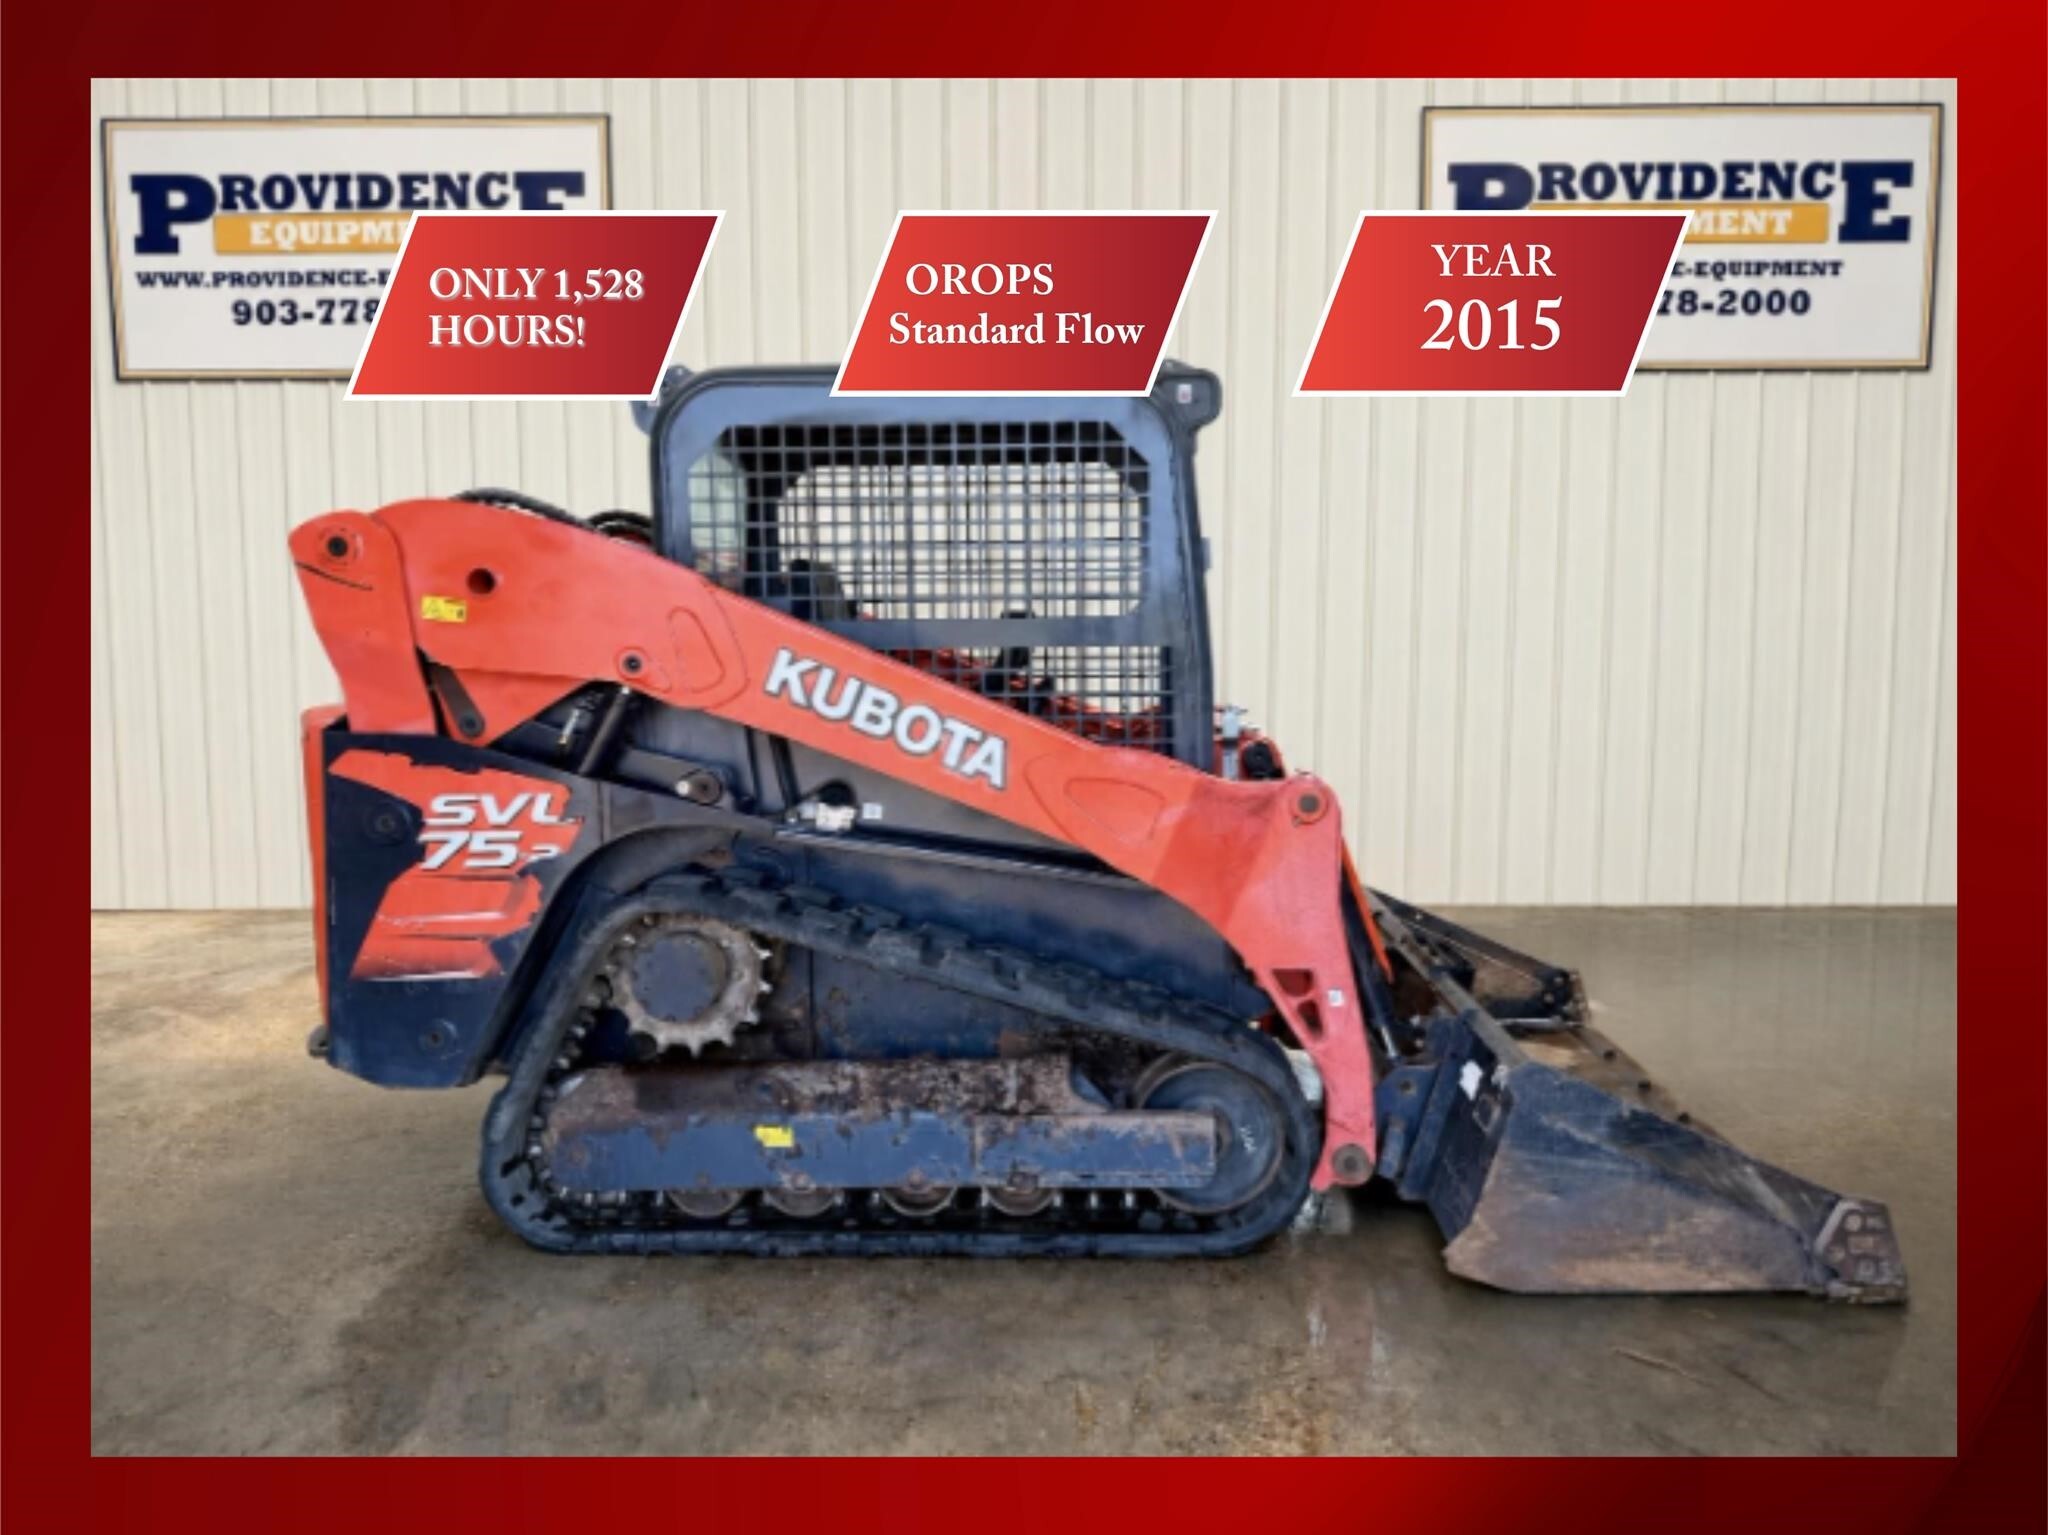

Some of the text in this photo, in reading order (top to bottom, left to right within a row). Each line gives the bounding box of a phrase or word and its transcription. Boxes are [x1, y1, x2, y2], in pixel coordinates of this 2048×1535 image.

[232, 298, 380, 327] 903-778
[763, 647, 1008, 790] KUBOTA
[424, 792, 577, 827] SVL
